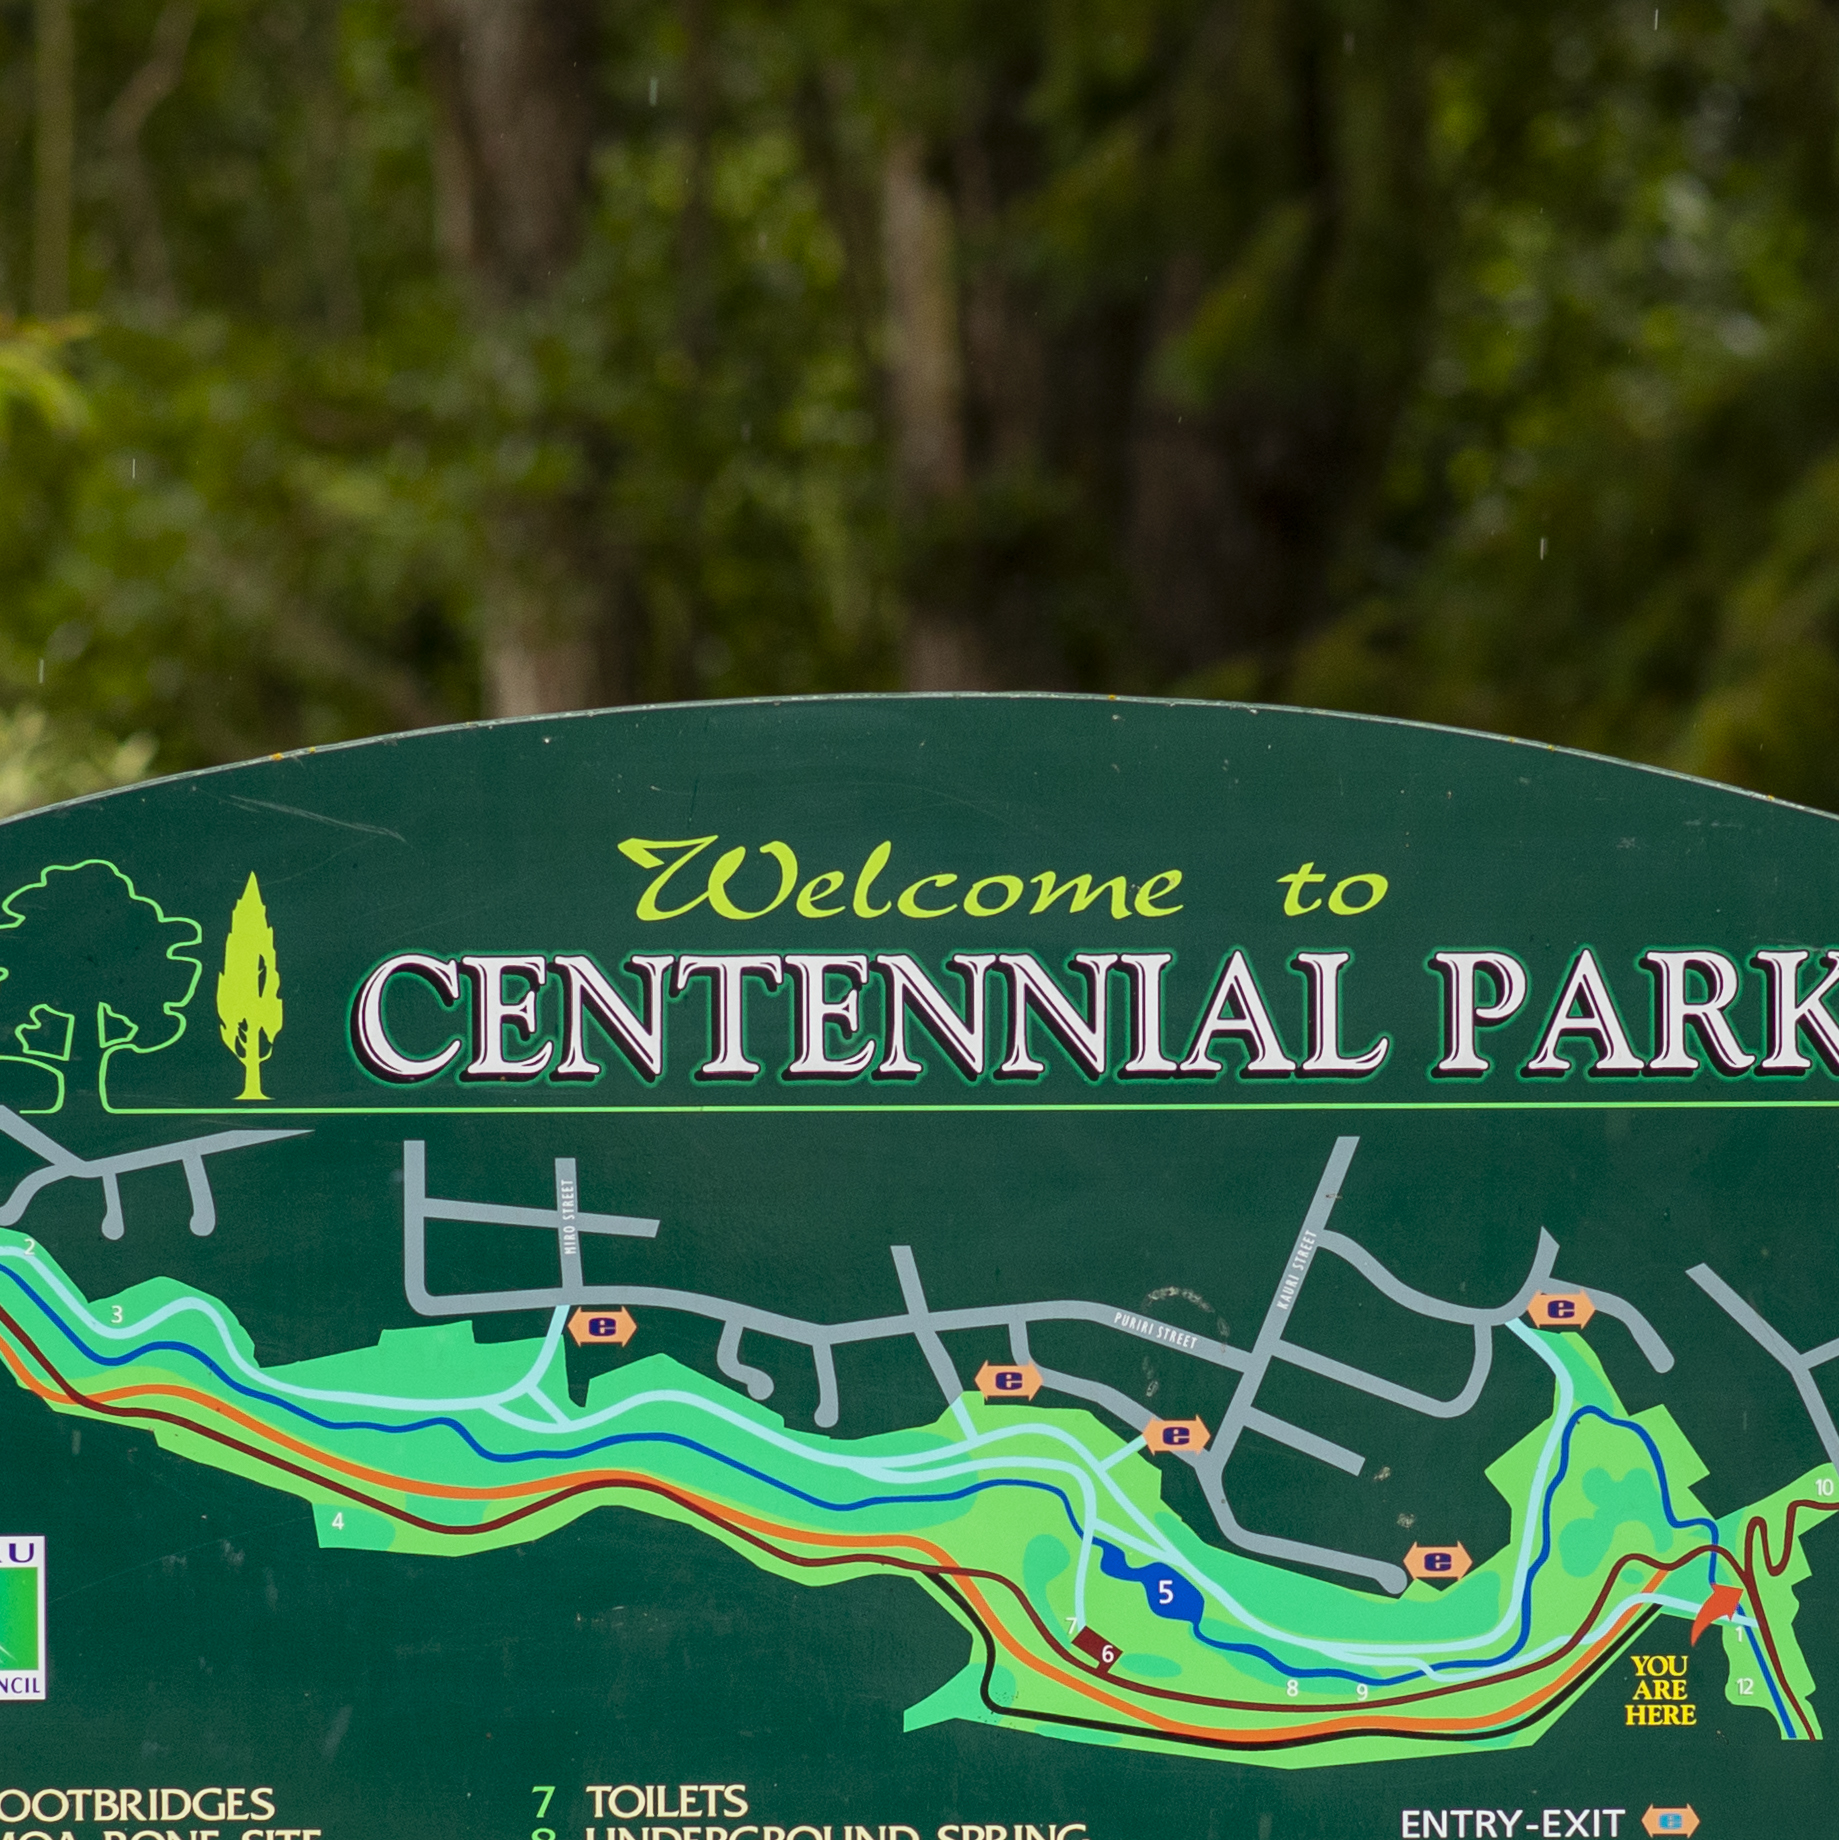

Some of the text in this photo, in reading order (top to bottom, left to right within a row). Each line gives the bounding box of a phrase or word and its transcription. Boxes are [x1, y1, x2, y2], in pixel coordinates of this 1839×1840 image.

[617, 835, 1389, 921] Welcome to
[356, 950, 1390, 1082] CENTENNIAL
[560, 1179, 577, 1255] MIRO STREET
[24, 1238, 36, 1256] 2
[1276, 1229, 1317, 1310] KAURI STREET
[111, 1304, 124, 1324] 3
[1113, 1311, 1198, 1350] PURIRI STREET
[1815, 1479, 1834, 1497] 10
[331, 1511, 345, 1531] 4
[1158, 1580, 1174, 1604] 5
[1065, 1616, 1077, 1635] 7
[1735, 1625, 1743, 1643] 1
[1102, 1644, 1114, 1663] 6
[1630, 1656, 1689, 1677] YOU
[1286, 1679, 1299, 1698] 8
[1356, 1683, 1369, 1701] 9
[1632, 1679, 1688, 1701] ARE
[1736, 1677, 1754, 1696] 12
[1625, 1704, 1698, 1726] HERE
[531, 1783, 749, 1819] 7 TOILETS
